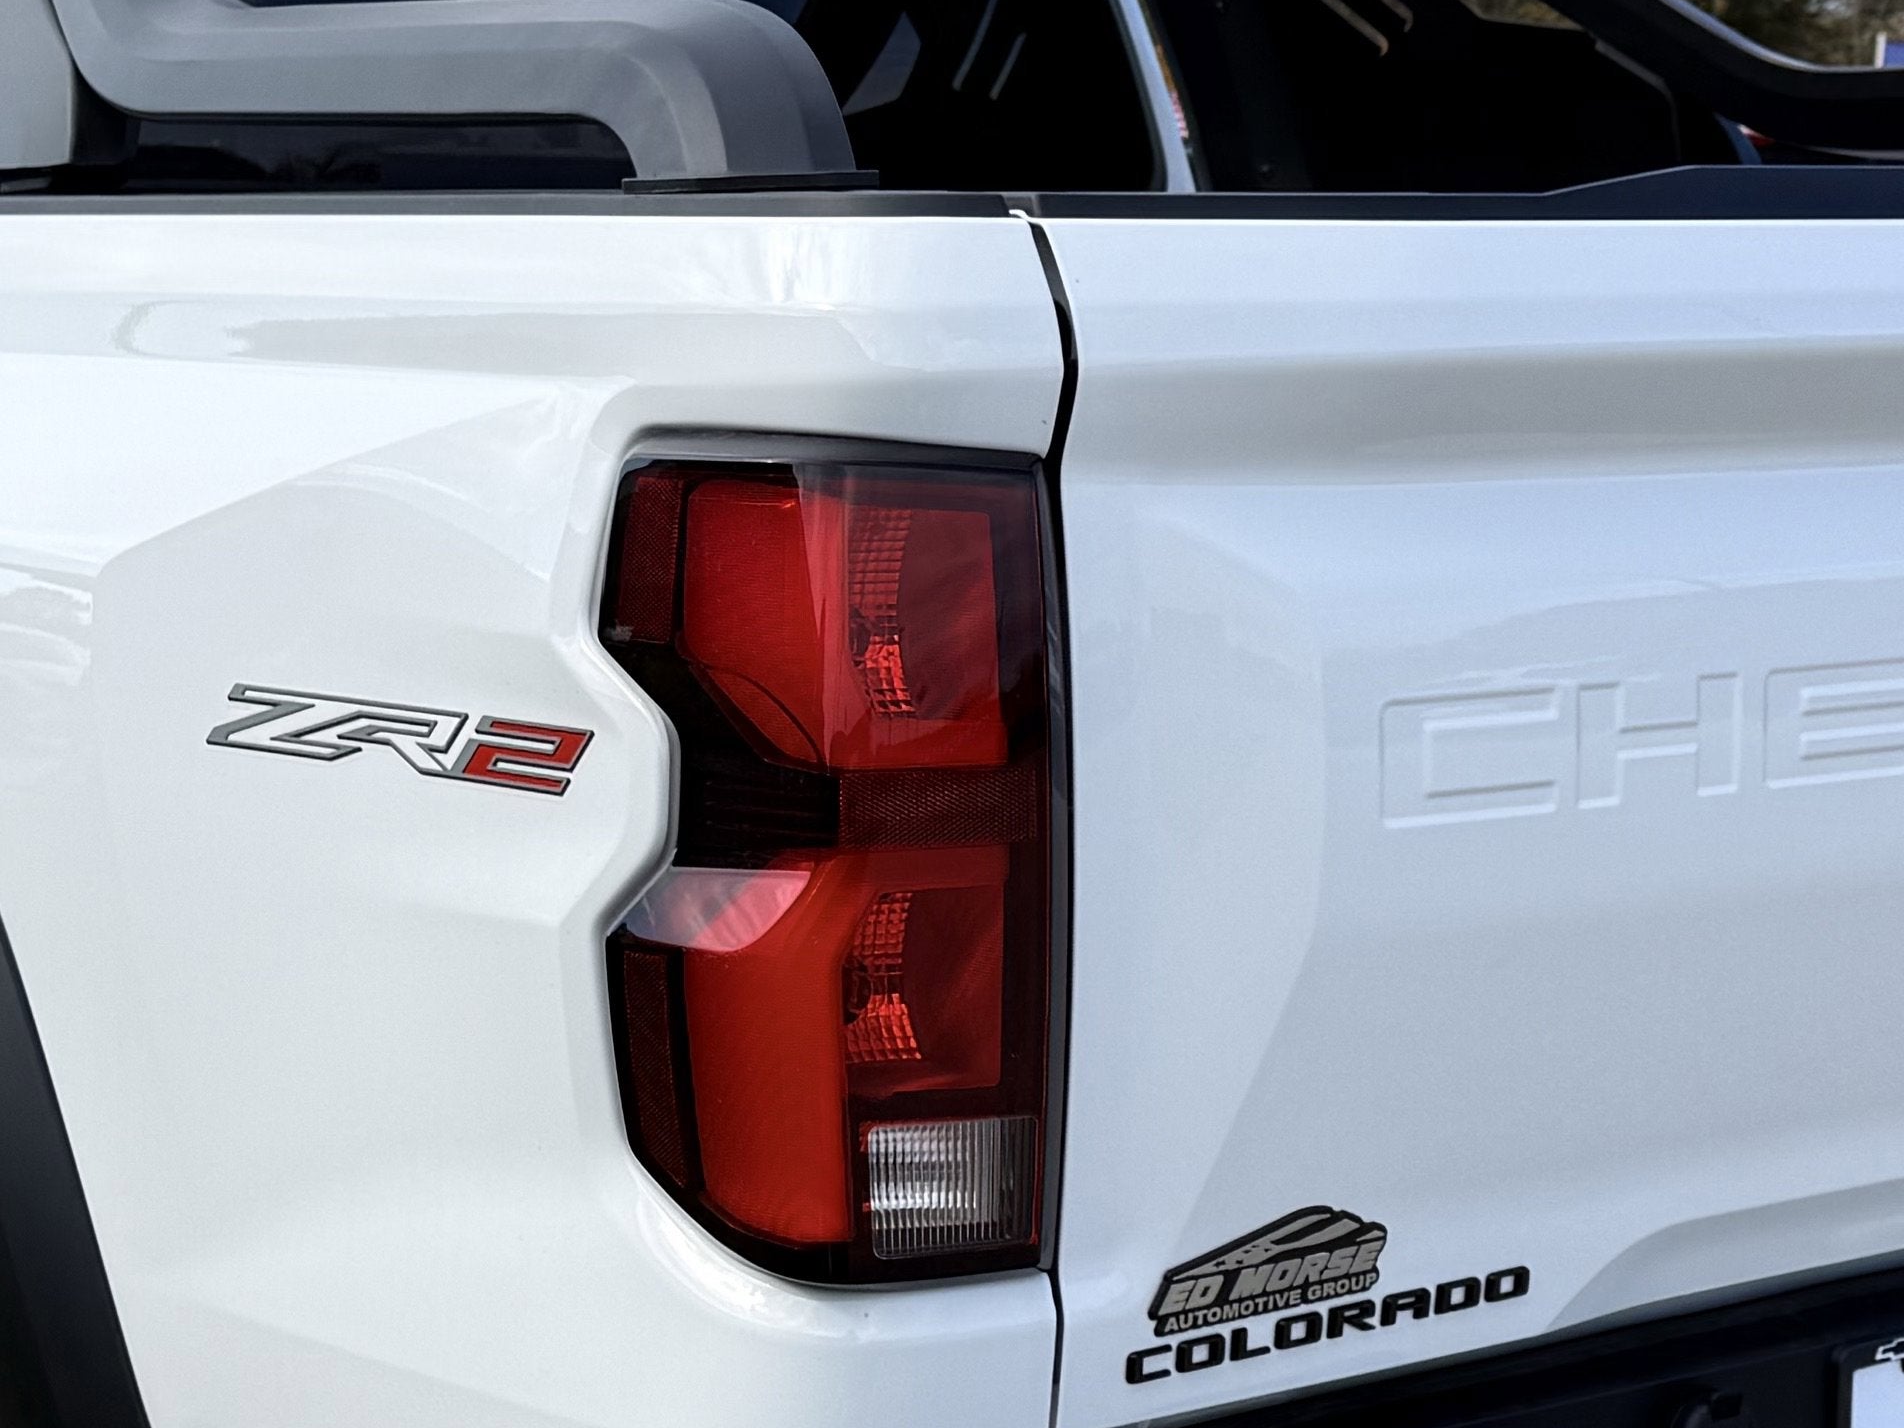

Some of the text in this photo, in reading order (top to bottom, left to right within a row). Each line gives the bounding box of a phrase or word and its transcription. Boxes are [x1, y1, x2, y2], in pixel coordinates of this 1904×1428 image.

[206, 682, 595, 797] ZR2
[1124, 1265, 1530, 1385] COLORADO
[1157, 1239, 1386, 1316] ED MORSE
[1164, 1272, 1378, 1333] AUTOMOTIVE GROUP
